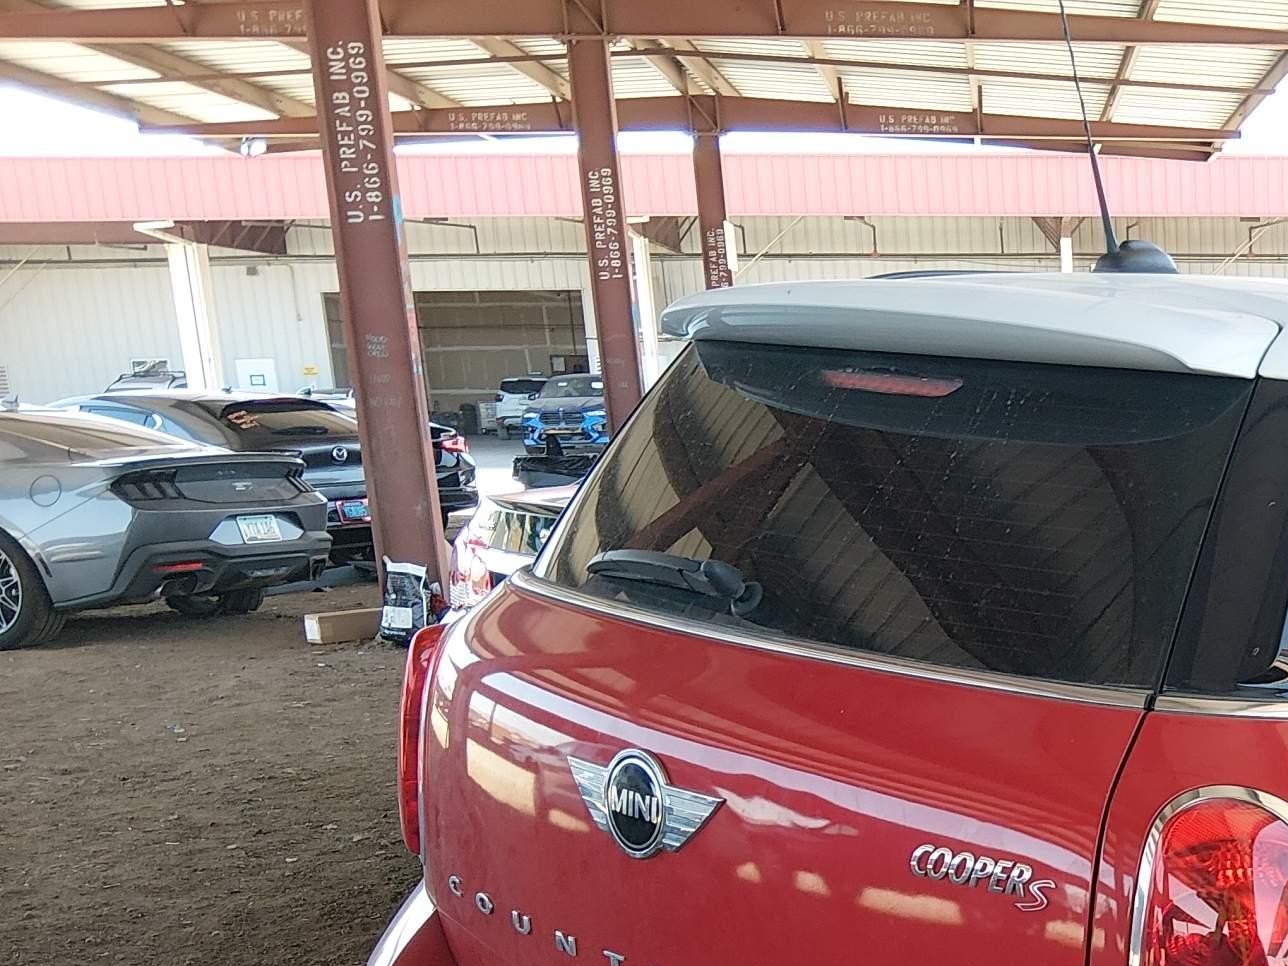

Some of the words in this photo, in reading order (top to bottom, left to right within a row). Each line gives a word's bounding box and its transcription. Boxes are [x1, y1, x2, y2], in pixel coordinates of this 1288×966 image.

[326, 40, 348, 81] INC.
[332, 91, 359, 173] PREFAB
[347, 41, 385, 221] 1-866-799-0969
[345, 183, 365, 224] U.S.
[591, 198, 607, 249] PREFAB
[600, 167, 624, 279] 1-866-799-0969
[708, 250, 720, 287] PREFAB
[609, 785, 658, 825] MINI
[909, 843, 1033, 898] COOPER
[1014, 879, 1056, 912] S
